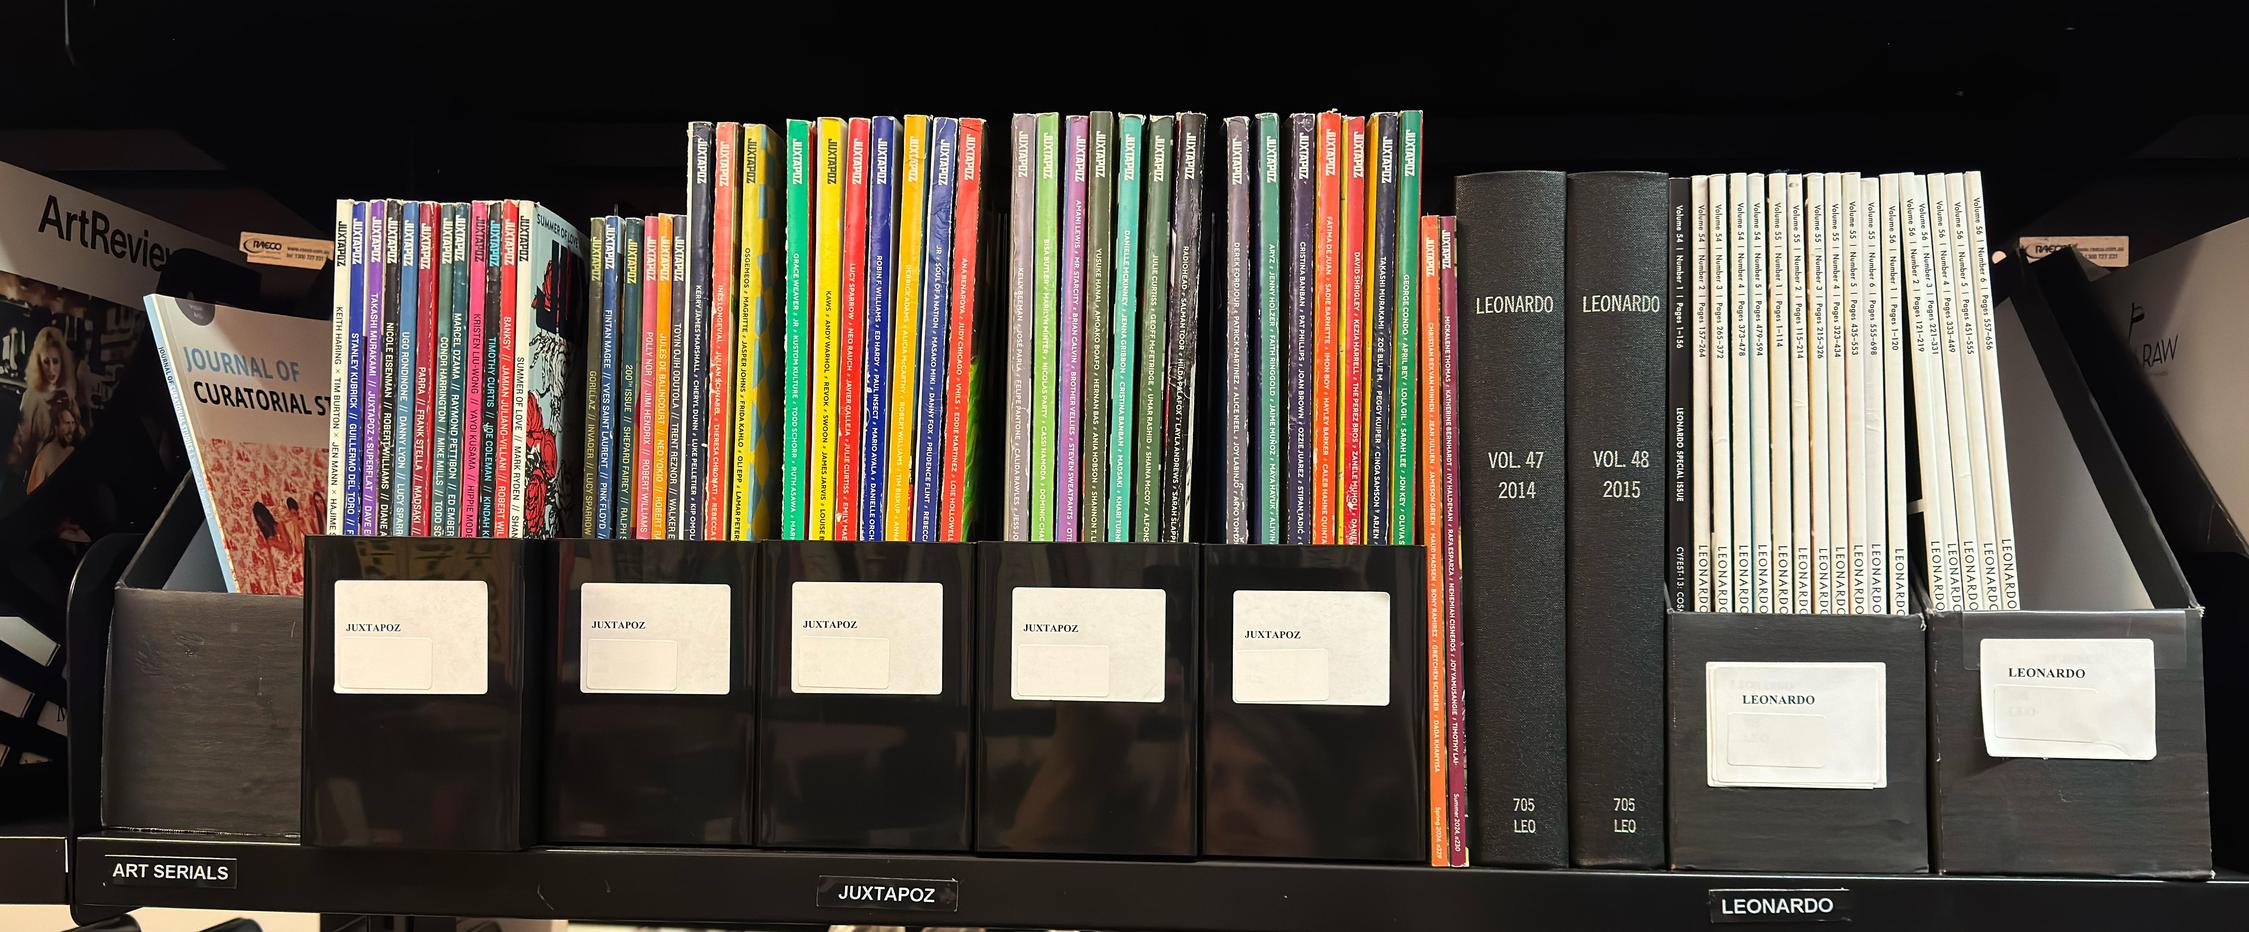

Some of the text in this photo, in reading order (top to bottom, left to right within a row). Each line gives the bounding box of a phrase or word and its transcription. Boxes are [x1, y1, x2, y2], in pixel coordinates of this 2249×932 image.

[697, 138, 707, 184] JUXTAPOZ
[719, 141, 729, 186] JUXTAPOZ
[746, 138, 757, 184] JUXTAPOZ
[792, 139, 803, 184] JUXTAPOZ
[827, 139, 837, 184] JUXTAPOZ
[852, 138, 862, 185] JUXTAPOZ
[876, 138, 887, 184] JUXTAPOZ
[908, 136, 919, 182] JUXTAPOZ
[938, 139, 949, 185] JUXTAPOZ
[965, 134, 975, 180] JUXTAPOZ
[1018, 131, 1028, 177] JUXTAPOZ
[1043, 133, 1053, 178] JUXTAPOZ
[1075, 135, 1085, 182] JUXTAPOZ
[1096, 131, 1105, 177] JUXTAPOZ
[1125, 134, 1134, 180] JUXTAPOZ
[1154, 135, 1164, 182] JUXTAPOZ
[1185, 133, 1196, 179] JUXTAPOZ
[1232, 138, 1242, 185] JUXTAPOZ
[1266, 136, 1276, 183] JUXTAPOZ
[1299, 133, 1308, 179] JUXTAPOZ
[1326, 129, 1336, 176] JUXTAPOZ
[1354, 131, 1363, 178] JUXTAPOZ
[1382, 136, 1392, 183] JUXTAPOZ
[1405, 129, 1415, 176] JUXTAPOZ
[1676, 206, 1684, 230] Volume
[1868, 203, 1876, 227] Volume
[1973, 198, 1983, 222] Volume
[1976, 226, 1984, 235] 56
[38, 194, 170, 272] ArtRevie
[337, 221, 347, 266] JUXTAPOZ
[352, 218, 363, 264] JUXTAPOZ
[370, 216, 382, 262] JUXTAPOZ
[386, 217, 398, 263] JUXTAPOZ
[403, 220, 414, 266] JUXTAPOZ
[420, 223, 432, 269] JUXTAPOZ
[442, 218, 453, 264] JUXTAPOZ
[455, 215, 466, 261] JUXTAPOZ
[475, 216, 486, 262] JUXTAPOZ
[489, 220, 500, 267] JUXTAPOZ
[504, 219, 515, 265] JUXTAPOZ
[519, 216, 531, 262] JUXTAPOZ
[606, 224, 616, 269] JUXTAPOZ
[1442, 230, 1451, 269] JUXTAPOZ
[1676, 234, 1684, 243] 54
[1868, 230, 1876, 240] 55
[592, 236, 602, 281] JUXTAPOZ
[628, 239, 638, 283] JUXTAPOZ
[646, 236, 656, 281] JUXTAPOZ
[660, 236, 670, 281] JUXTAPOZ
[674, 236, 685, 281] JUXTAPOZ
[742, 248, 750, 288] OSGEMEOS
[1426, 237, 1434, 276] JUXTAPOZ
[1676, 255, 1684, 283] Number
[1869, 253, 1877, 279] Number
[1977, 248, 1987, 274] Number
[1476, 295, 1553, 314] LEONARDO
[1583, 295, 1660, 313] LEONARDO
[1675, 303, 1684, 323] Pages
[1868, 300, 1877, 320] Pages
[1980, 295, 1990, 315] Pages
[183, 346, 301, 382] JOURNAL OF
[823, 341, 831, 373] WARHOL
[193, 381, 312, 415] CURATORIAL
[330, 307, 343, 529] KEITH HARING TIM BURTON JEN MANN HAJIME
[449, 313, 462, 479] MARCEL DZAMA RAYMOND PETTIBON
[497, 317, 511, 517] BANKSY JAMIAN JULIANO-VILLANI ROBERT
[347, 333, 359, 514] STANLEY KUBRICK GUILLERMO DEL TORO
[513, 357, 524, 500] SUMMER OF LOVE MARK RYDEN
[599, 310, 612, 529] FINTAN MAGEE YVES SAINT LAURENT PINK FLOYD
[669, 324, 681, 532] TOYIN OJIH ODUTOLA TRENT REZNOR WALKER
[821, 415, 829, 442] SWOON
[1488, 452, 1544, 468] VOL. 47
[1593, 450, 1650, 468] VOL. 48
[1498, 481, 1536, 498] 2014
[1603, 481, 1640, 498] 2015
[1871, 544, 1882, 613] LEONARDO
[2002, 539, 2016, 609] LEONARDO
[345, 623, 401, 633] JUXTAPOZ
[591, 620, 646, 630] JUXTAPOZ
[802, 620, 858, 629] JUXTAPOZ
[1023, 625, 1079, 633] JUXTAPOZ
[1244, 631, 1301, 640] JUXTAPOZ
[2008, 667, 2086, 679] LEONARDO
[1742, 694, 1815, 705] LEONARDO
[1513, 798, 1535, 811] 705
[1514, 819, 1536, 833] LEO
[1613, 798, 1635, 811] 705
[1614, 819, 1636, 833] LEO
[112, 863, 229, 880] ART SERIALS
[838, 885, 935, 903] JUXTAPOZ
[1721, 898, 1834, 915] LEONARDO
